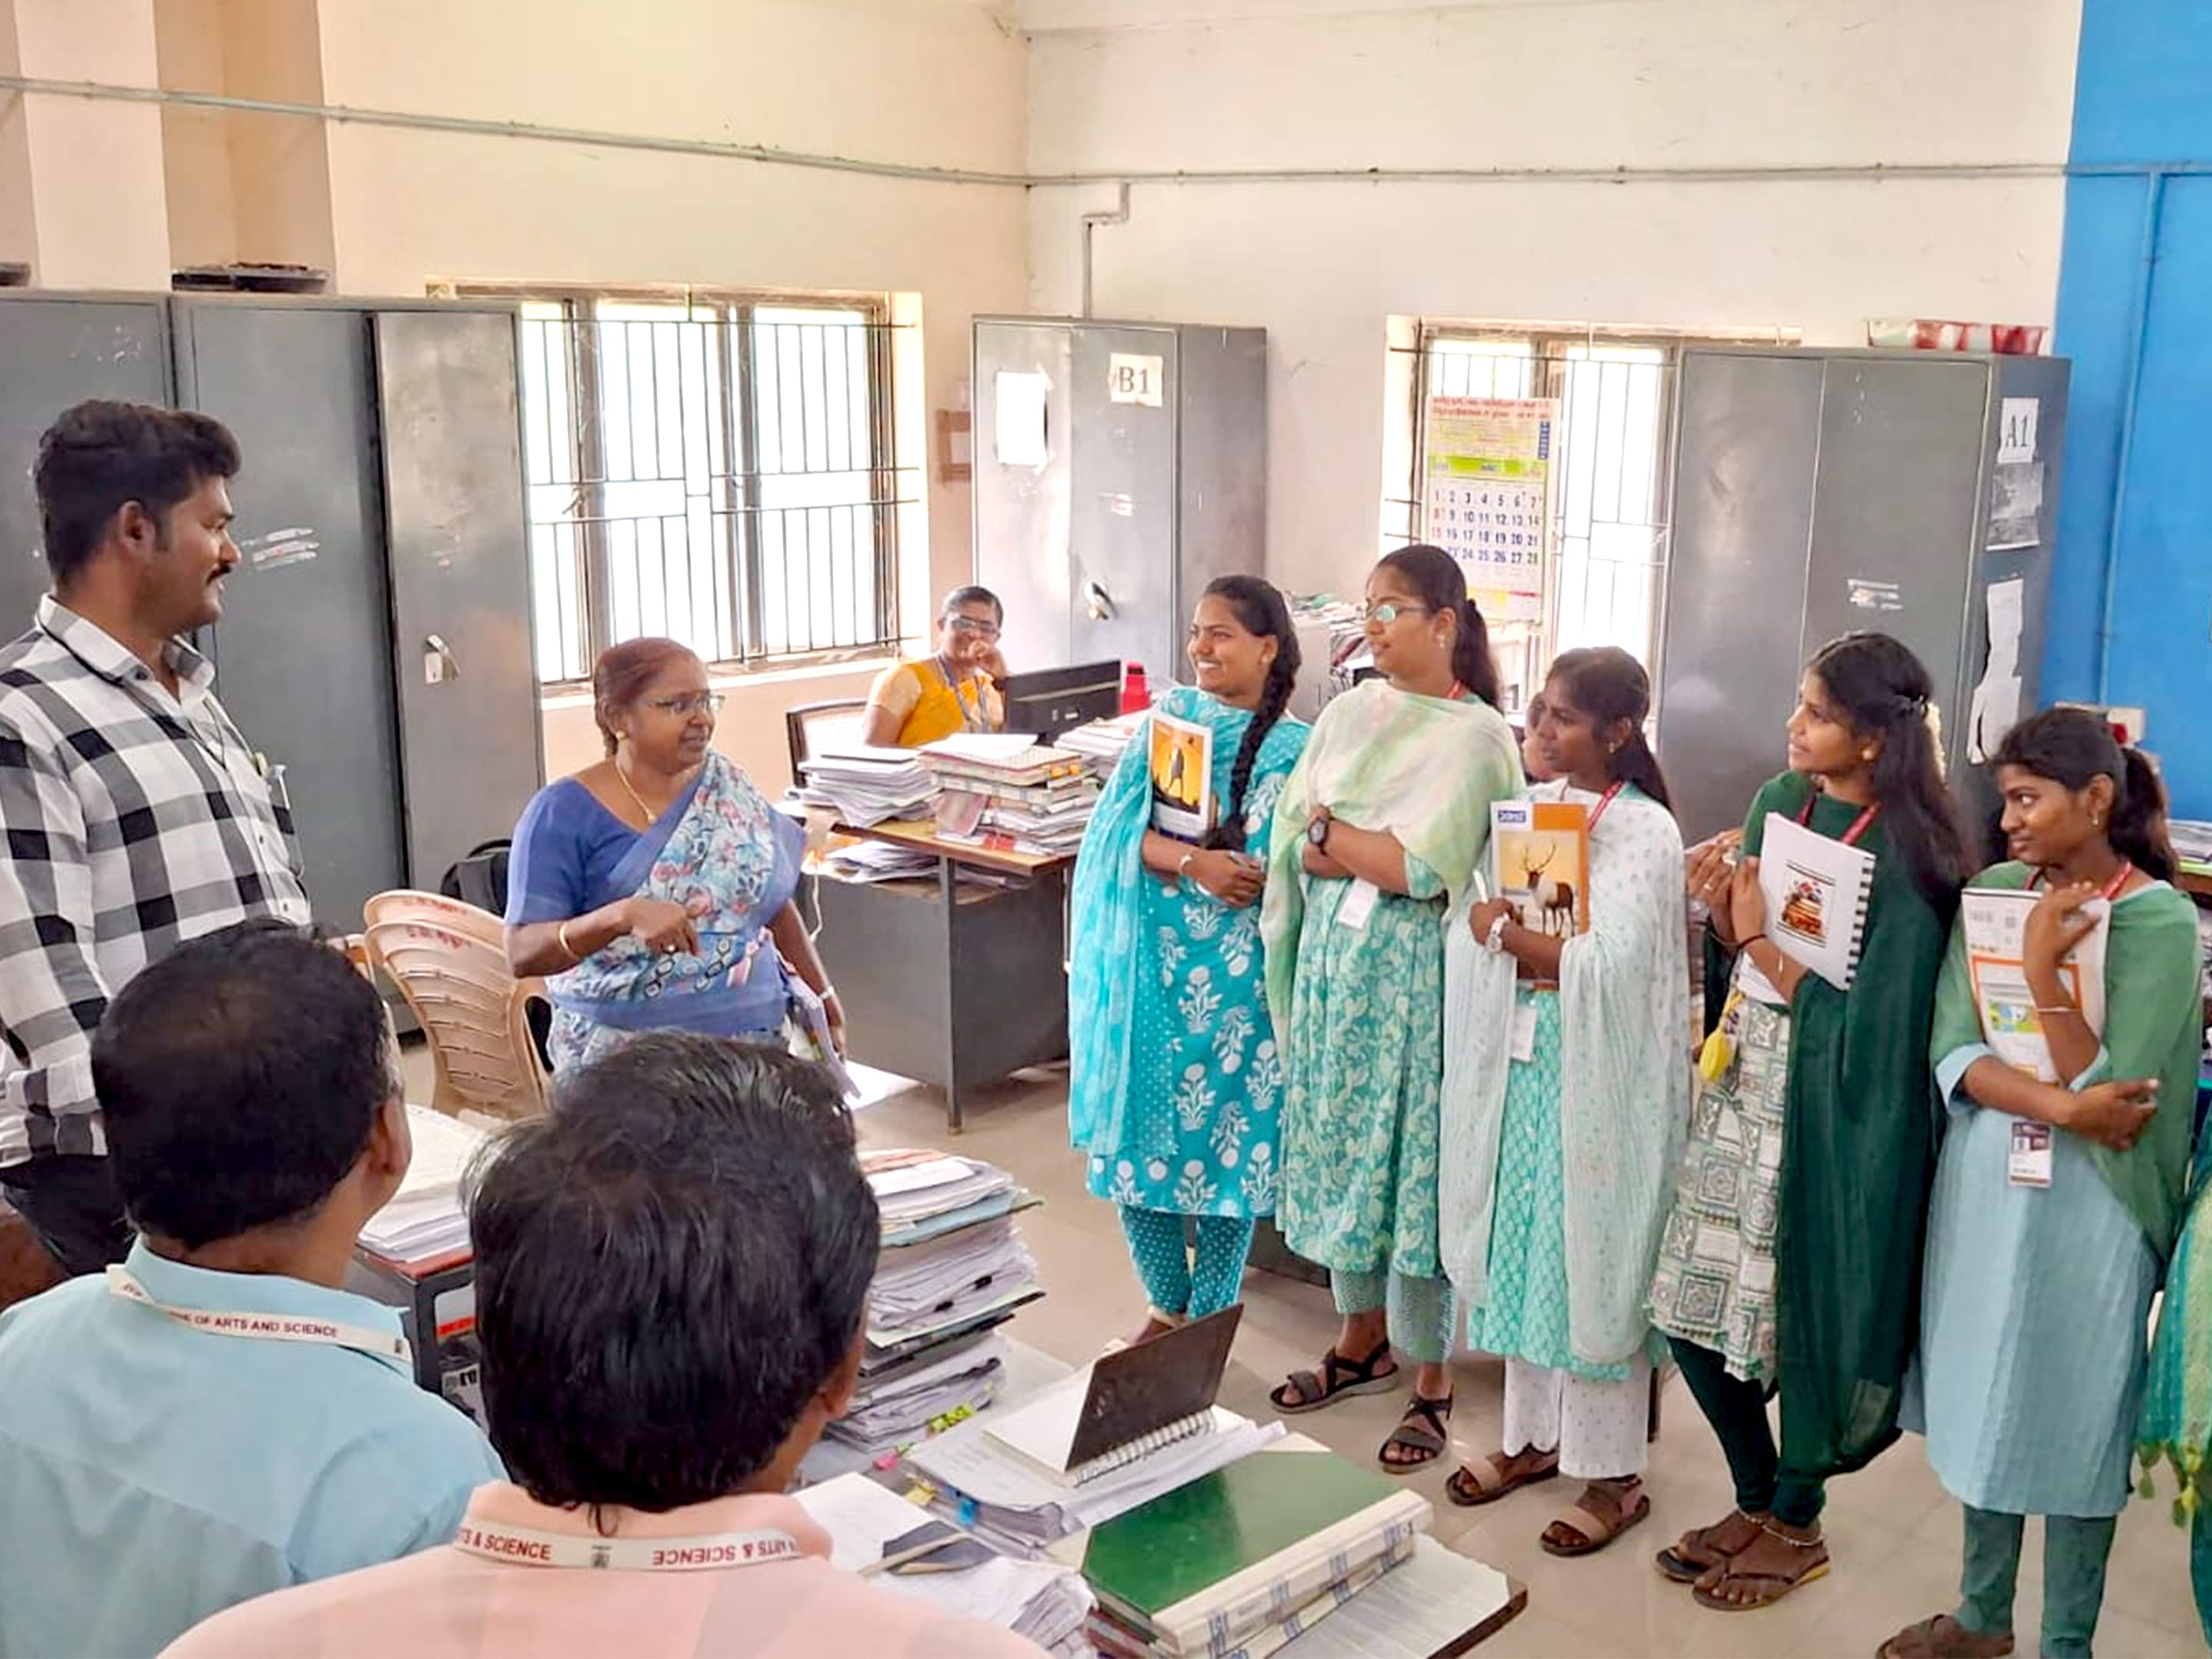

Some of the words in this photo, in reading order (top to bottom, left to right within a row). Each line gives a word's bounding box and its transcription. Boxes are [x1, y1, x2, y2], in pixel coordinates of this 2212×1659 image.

[1119, 366, 1151, 393] B1
[2005, 416, 2030, 447] A1
[1465, 492, 1471, 504] 3
[1481, 493, 1488, 505] 4
[1498, 494, 1504, 507] 5
[1514, 495, 1520, 507] 6
[1464, 511, 1475, 523] 10
[1479, 512, 1489, 523] 11
[1495, 513, 1507, 525] 12
[1512, 514, 1523, 526] 13
[1463, 530, 1473, 541] 17
[1479, 530, 1489, 543] 18
[1495, 532, 1506, 544] 19
[1512, 533, 1523, 545] 20
[1528, 534, 1538, 546] 21
[1512, 551, 1522, 564] 27
[214, 1316, 247, 1330] ARTS
[250, 1320, 279, 1332] AND
[283, 1322, 338, 1338] SCIENCE
[485, 1534, 551, 1561] SCIENCE
[653, 1545, 737, 1565] SCIENCE
